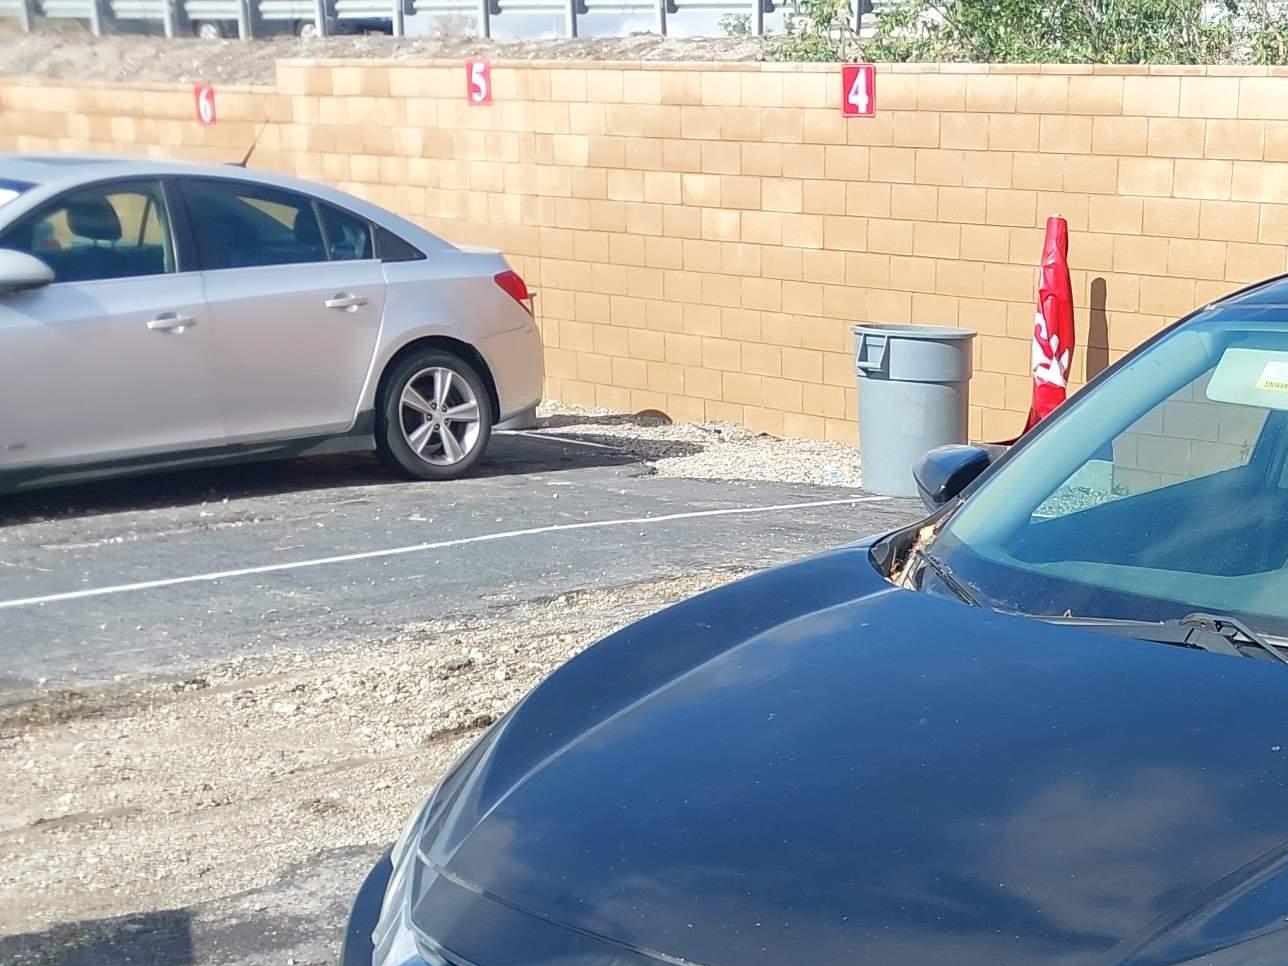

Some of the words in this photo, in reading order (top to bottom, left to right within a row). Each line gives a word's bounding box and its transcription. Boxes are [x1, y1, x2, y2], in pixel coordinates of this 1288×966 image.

[471, 63, 486, 101] 5
[848, 67, 869, 113] 4
[199, 88, 211, 122] 6
